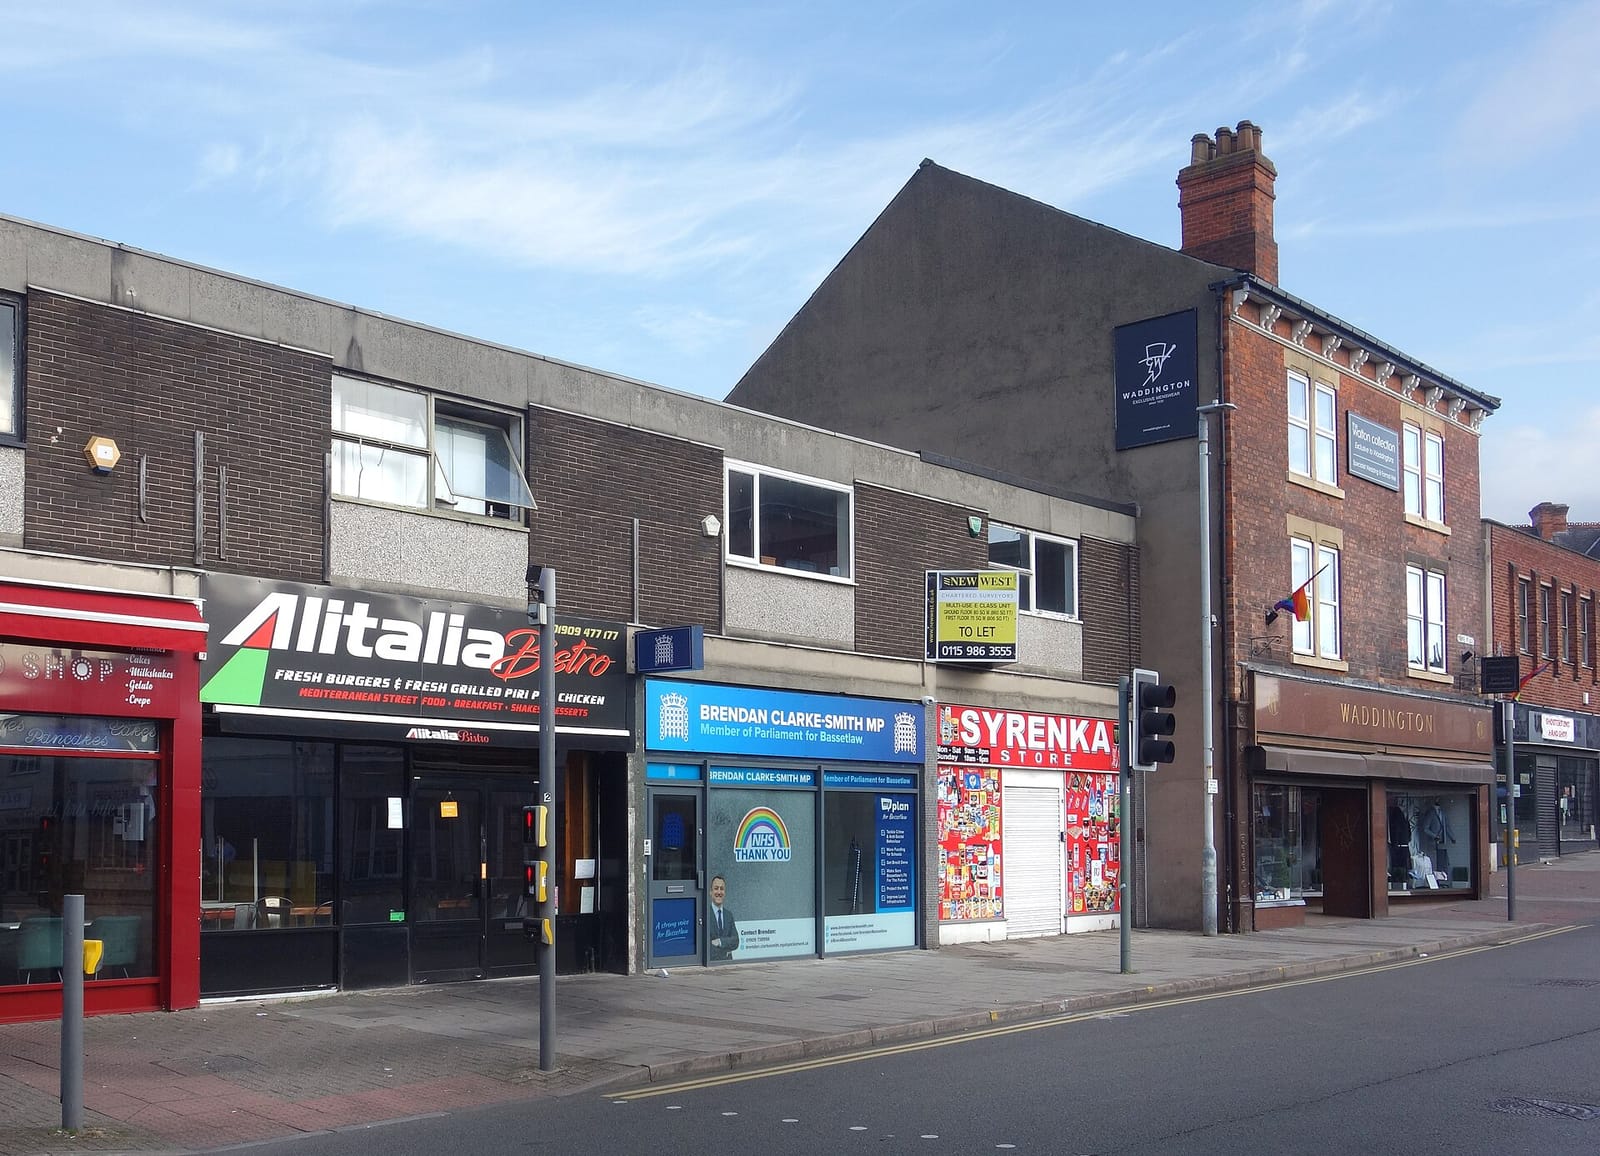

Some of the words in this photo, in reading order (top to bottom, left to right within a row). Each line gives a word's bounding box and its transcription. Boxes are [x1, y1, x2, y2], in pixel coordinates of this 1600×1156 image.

[1122, 380, 1190, 400] WADDINGTON
[1156, 392, 1180, 400] MENSWEAR
[950, 576, 977, 586] NEW
[980, 577, 1012, 586] WEST
[220, 592, 506, 670] Alitalia
[489, 628, 616, 682] Bstro
[583, 628, 602, 638] 477
[603, 631, 619, 640] 177
[959, 626, 972, 637] TO
[976, 626, 996, 637] LET
[942, 646, 962, 656] 0115
[966, 646, 985, 656] 986
[989, 647, 1012, 656] 3555
[130, 654, 151, 665] Cakes
[22, 652, 113, 682] SHOP
[130, 667, 174, 679] Milkshakes
[128, 680, 154, 693] Gelato
[274, 669, 323, 684] FRESH
[325, 674, 392, 688] BURGERS
[394, 677, 402, 690] &
[404, 680, 448, 692] FRESH
[450, 684, 502, 698] GRILLED
[504, 688, 530, 700] PIRI
[558, 692, 605, 706] CHICKEN
[129, 694, 151, 708] Crepe
[299, 688, 381, 702] MEDITERRANEAN
[383, 694, 418, 704] STREET
[421, 697, 446, 707] FOOD
[454, 699, 504, 711] BREAKFAST
[555, 706, 588, 718] ESSERTS
[700, 704, 768, 724] BRENDAN
[771, 710, 863, 730] CLARKE-SMITH
[866, 717, 885, 732] MP
[1340, 703, 1434, 733] WADDINGTON
[25, 727, 109, 747] Pancakes
[406, 728, 459, 740] Alitalia
[458, 730, 490, 742] Bistro
[700, 723, 740, 737] Member
[742, 726, 752, 738] of
[754, 727, 804, 741] Parliament
[806, 730, 818, 742] for
[820, 732, 864, 744] Bassetlaw
[960, 709, 1111, 754] SYRENKA
[952, 746, 961, 754] Sat
[1000, 750, 1072, 765] STORE
[746, 772, 798, 782] CLARKE-SMITH
[800, 774, 810, 783] MP
[850, 776, 878, 784] Parliament
[878, 776, 886, 784] for
[545, 793, 551, 801] 2
[892, 801, 909, 812] plan
[752, 834, 774, 847] NHS
[735, 849, 767, 860] THANK
[770, 849, 790, 860] YOU
